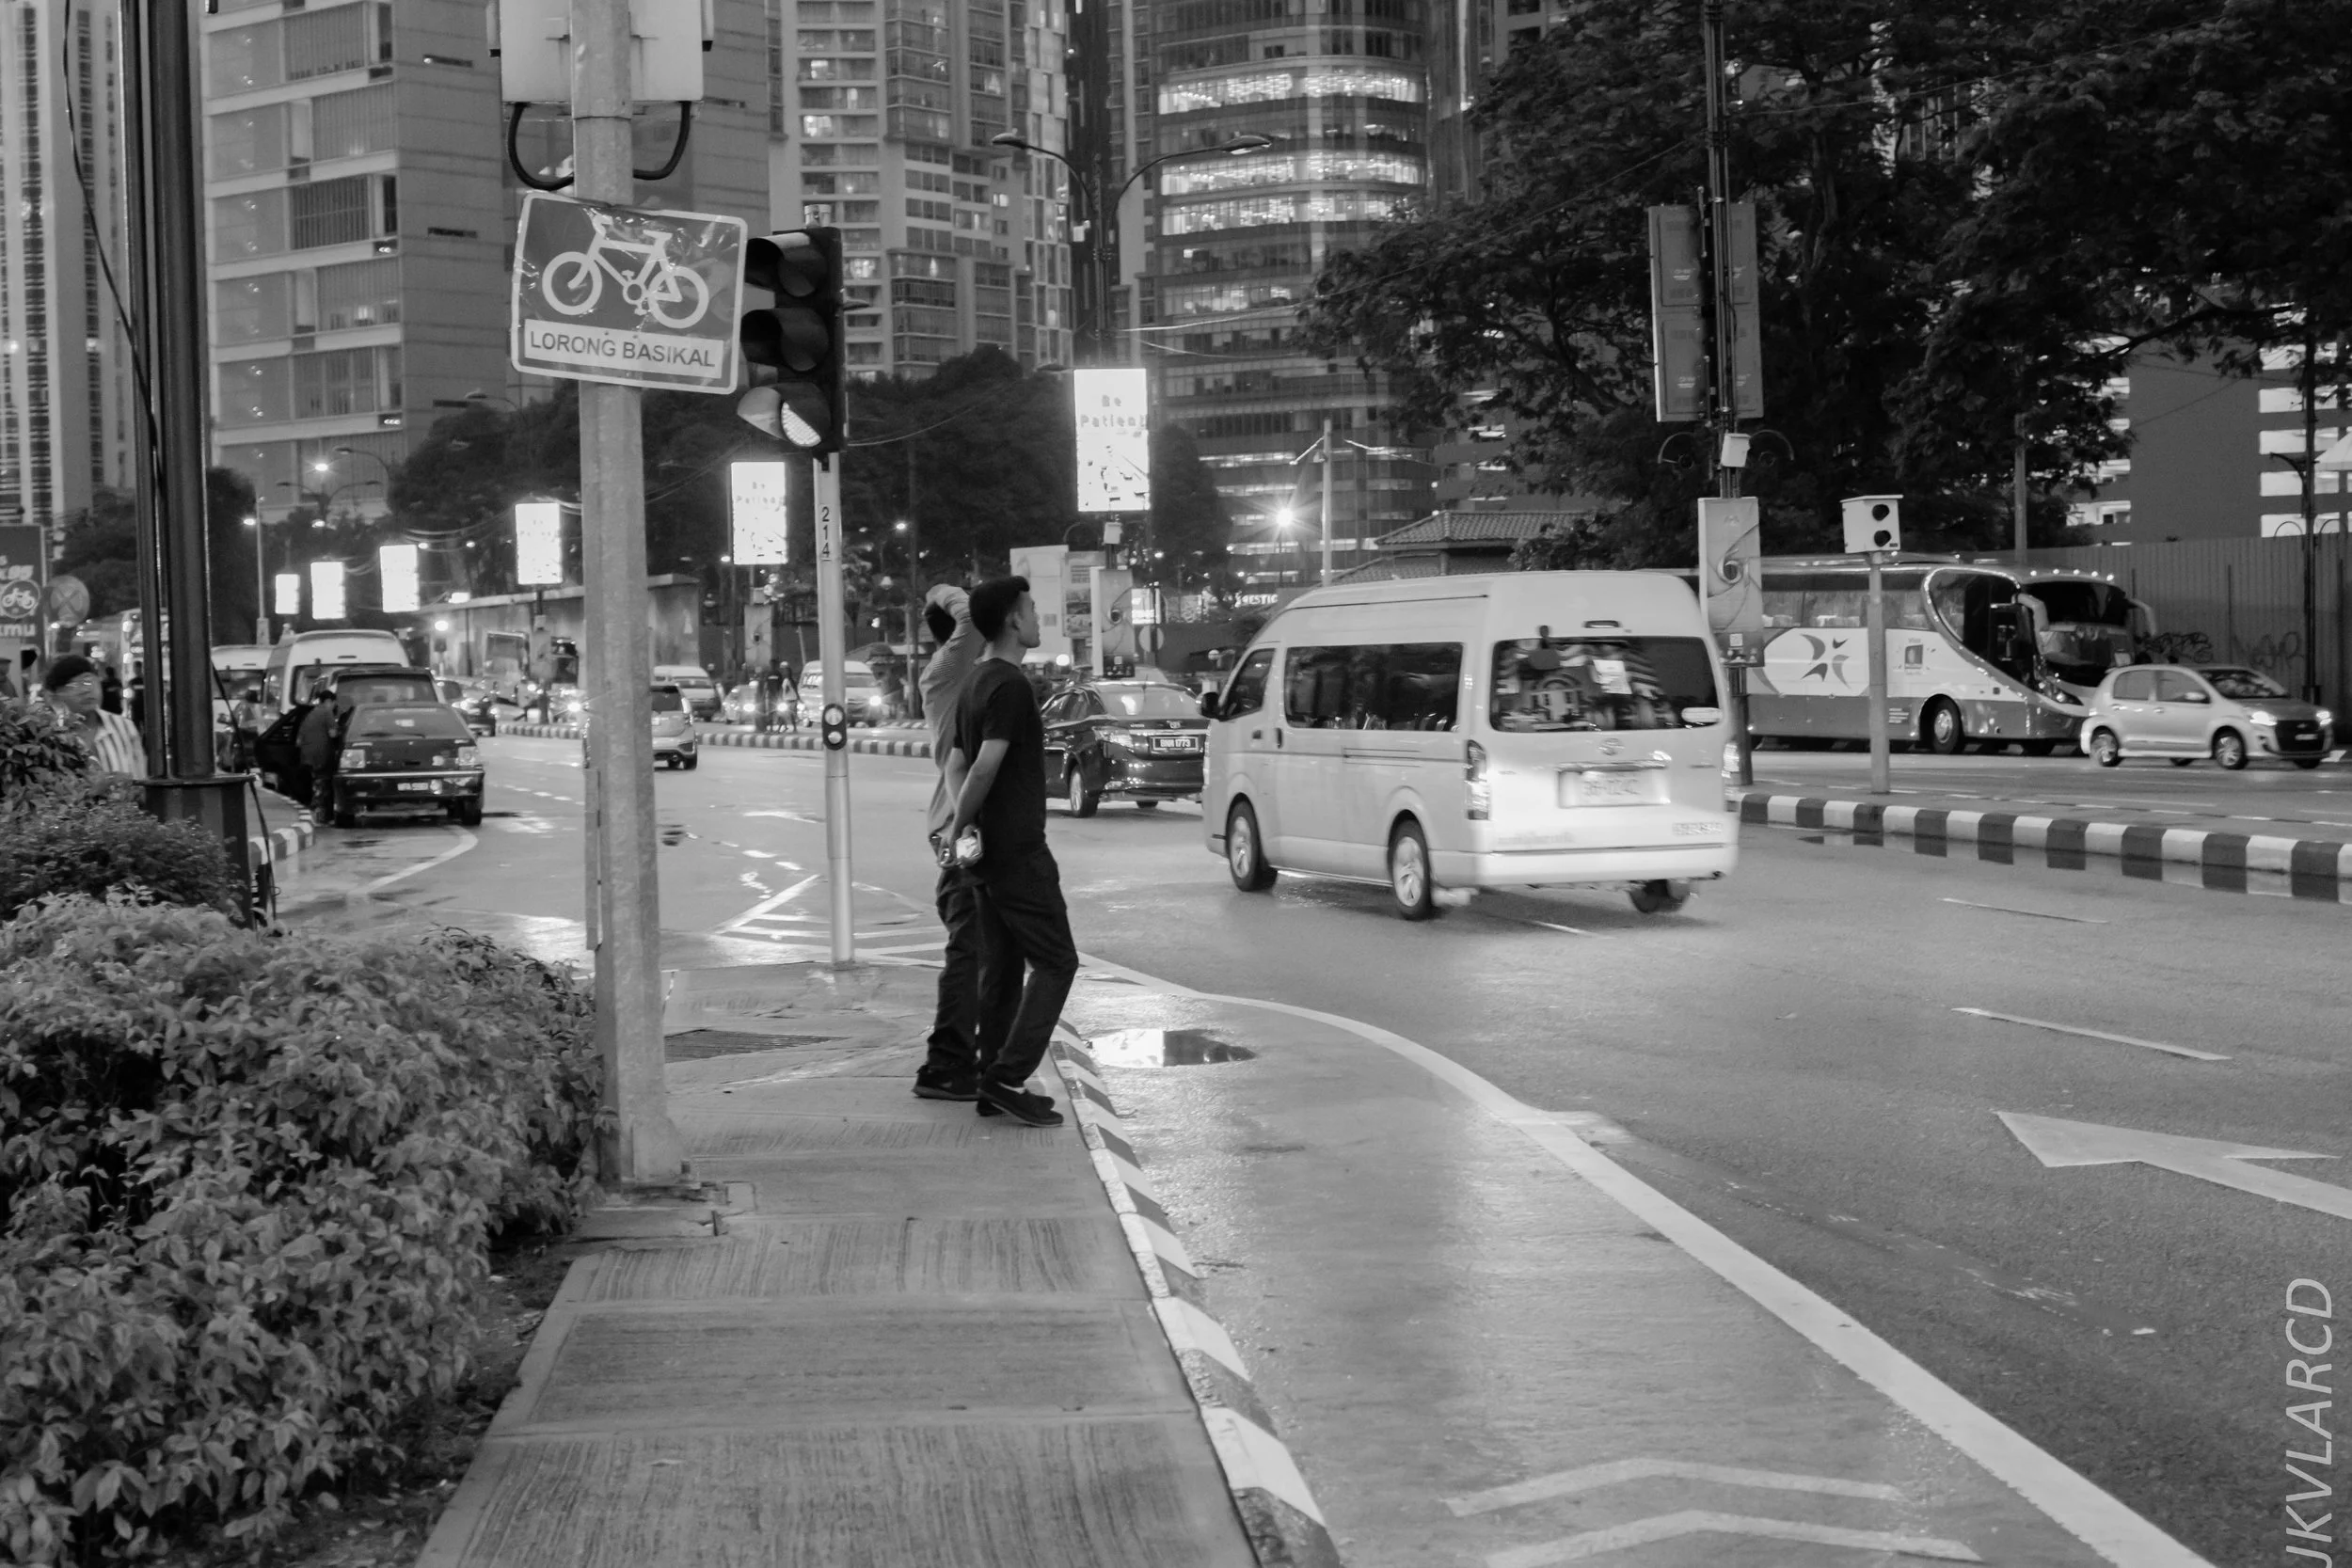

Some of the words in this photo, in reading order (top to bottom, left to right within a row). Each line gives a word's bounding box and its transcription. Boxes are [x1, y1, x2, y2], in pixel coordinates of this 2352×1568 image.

[530, 330, 616, 357] LORONG
[623, 341, 716, 368] BASIKAL
[1102, 394, 1122, 407] Be
